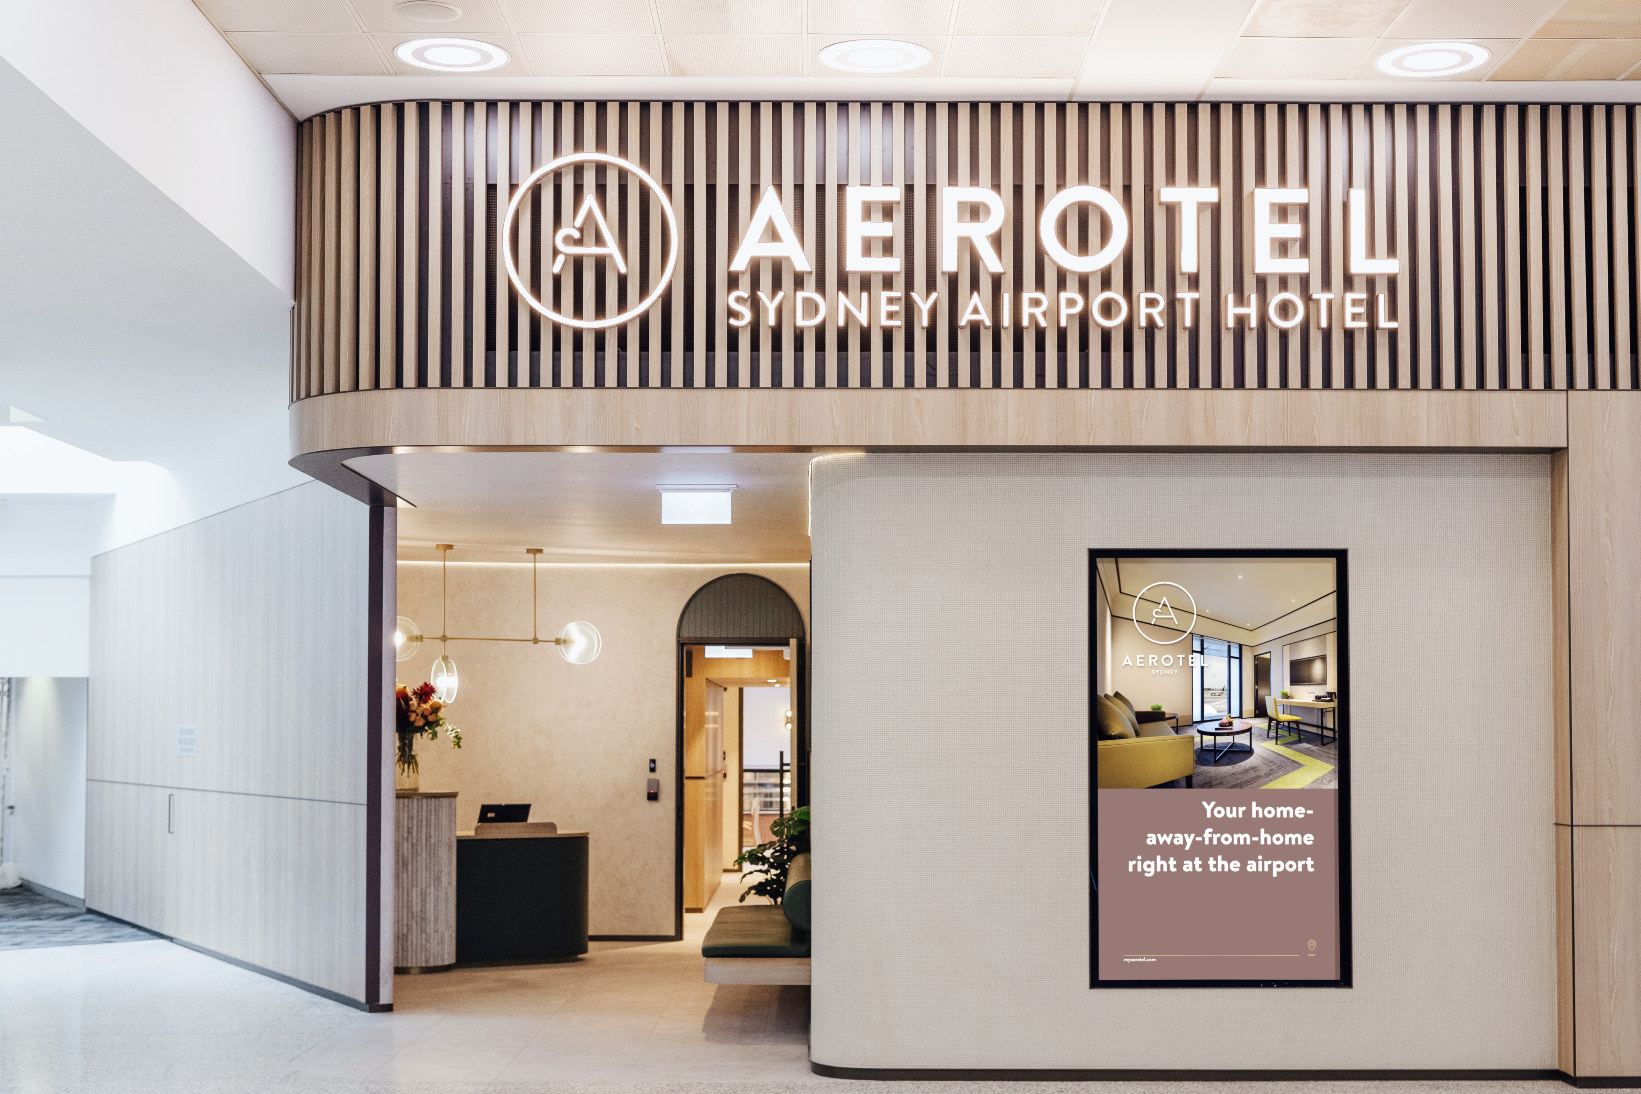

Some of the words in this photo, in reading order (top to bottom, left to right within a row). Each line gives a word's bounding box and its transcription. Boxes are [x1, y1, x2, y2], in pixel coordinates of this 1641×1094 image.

[728, 184, 1400, 275] AEROTEL
[727, 290, 938, 329] SYDNEY
[958, 290, 1200, 329] AIRPORT
[1226, 291, 1399, 329] HOTEL
[1121, 654, 1209, 667] AEROTEL
[1201, 801, 1247, 819] Your
[1251, 801, 1314, 819] home-
[1146, 828, 1315, 851] away-from-home
[1128, 855, 1177, 877] right
[1182, 857, 1203, 872] at
[1208, 855, 1241, 872] the
[1246, 855, 1315, 878] airport
